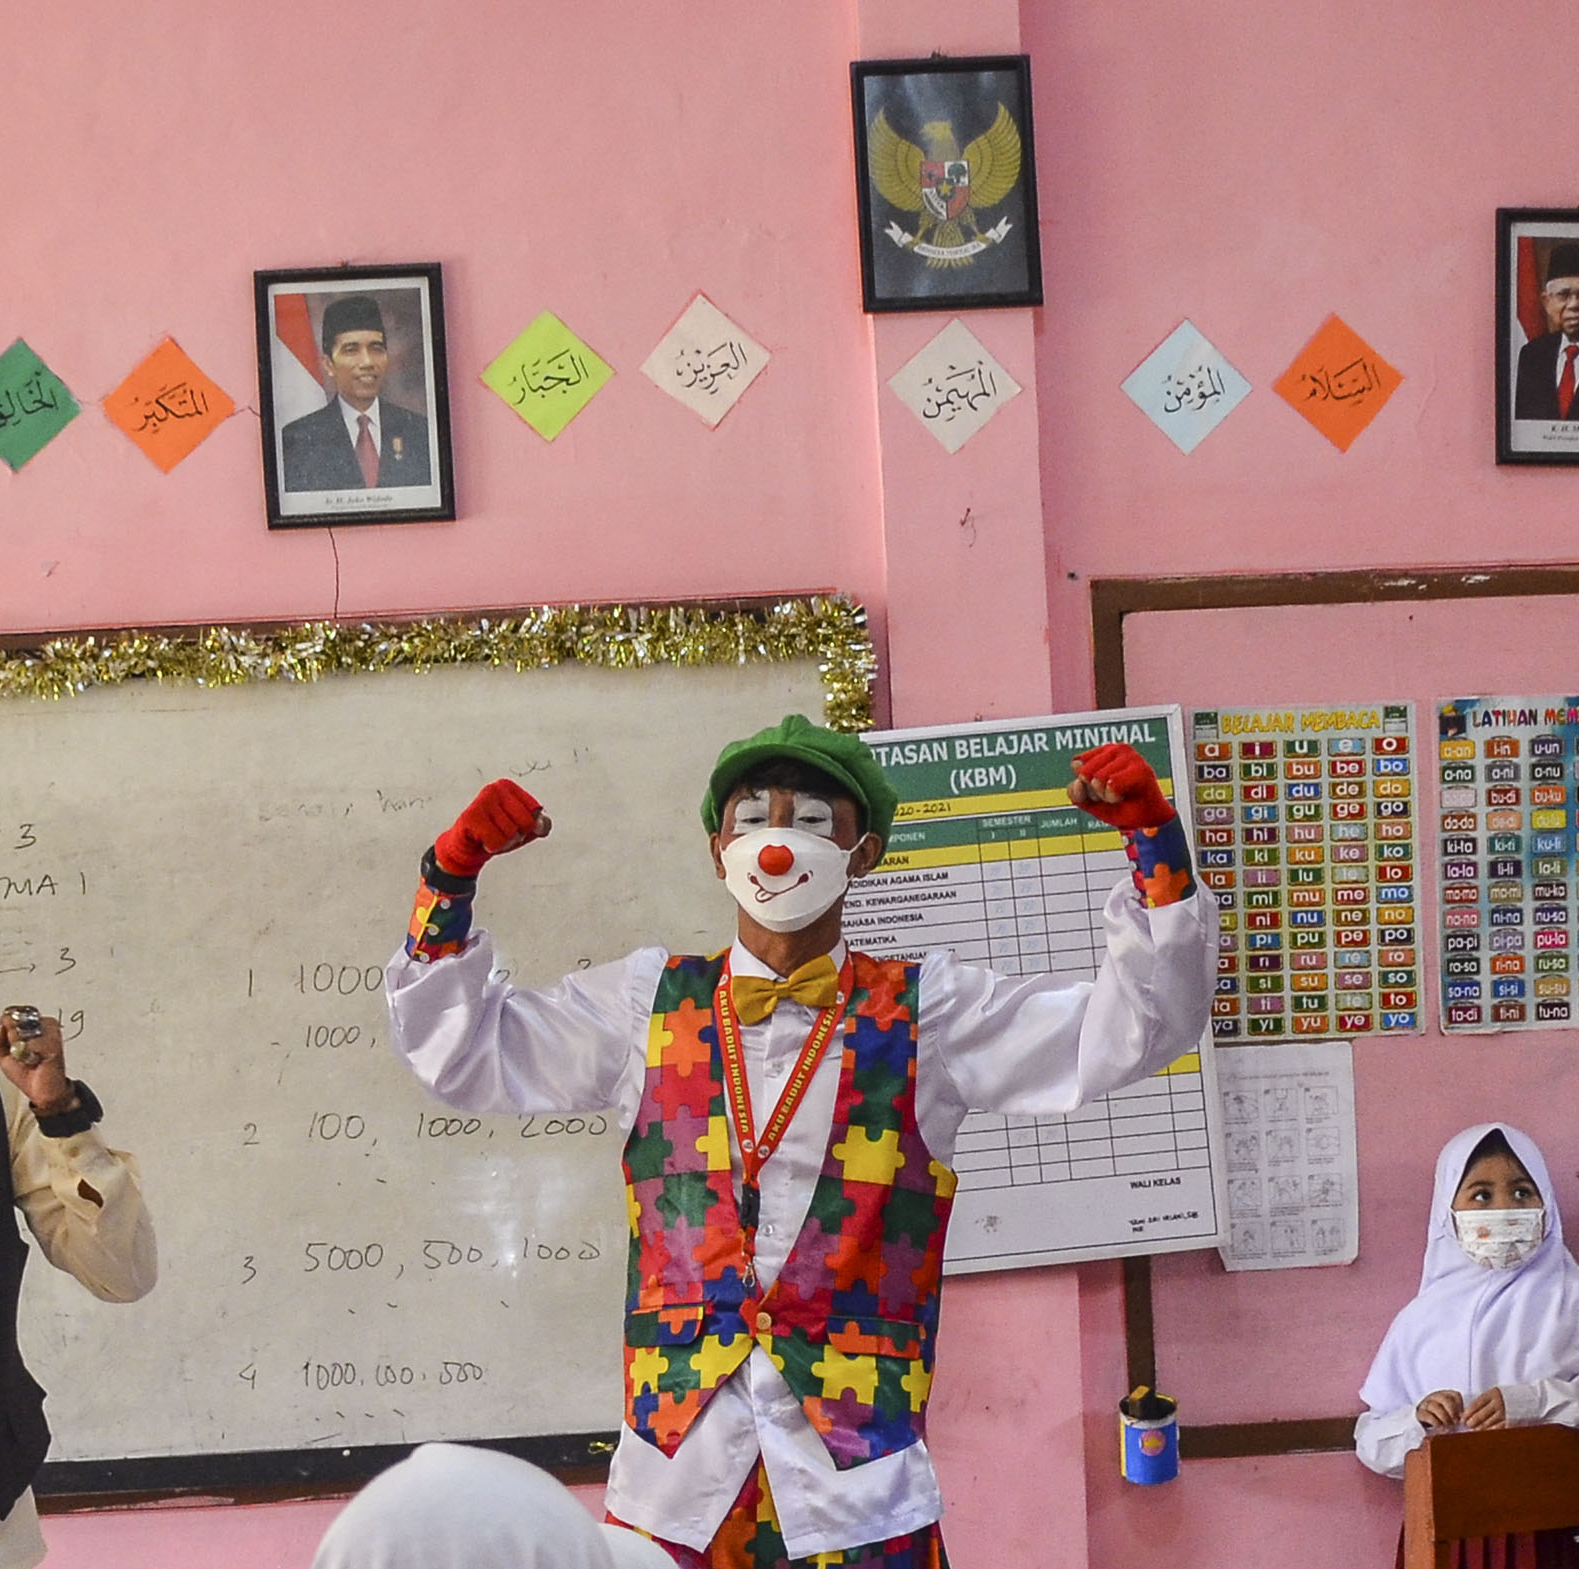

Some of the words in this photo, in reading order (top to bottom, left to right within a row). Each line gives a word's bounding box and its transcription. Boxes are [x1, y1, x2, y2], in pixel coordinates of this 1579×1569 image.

[1222, 711, 1295, 735] BELAJAR
[1300, 710, 1380, 733] MEMBACA
[1472, 705, 1538, 728] LATIHAN
[870, 741, 948, 767] TASAN
[955, 732, 1047, 760] BELAJAR
[1054, 722, 1156, 751] MINIMAL
[1204, 743, 1220, 757] a
[1254, 742, 1260, 756] i
[1294, 740, 1308, 753] u
[1382, 737, 1397, 751] o
[1493, 743, 1511, 756] i-in
[1534, 742, 1560, 754] u-un
[1203, 765, 1226, 779] ba
[1251, 764, 1267, 777] bi
[1292, 762, 1314, 775] bu
[1336, 761, 1359, 774] be
[1380, 759, 1403, 772] bo
[949, 764, 1017, 795] (KBM)
[1203, 787, 1226, 800] da
[1250, 786, 1267, 799] di
[1292, 784, 1314, 797] du
[1336, 783, 1359, 796] de
[1379, 781, 1402, 794] do
[1491, 790, 1517, 803] bu-di
[1534, 789, 1562, 802] bu-ku
[981, 815, 1031, 828] SEMESTER
[1040, 817, 1078, 828] JUMLAH
[1204, 808, 1227, 822] ga
[1251, 807, 1267, 820] gi
[1293, 805, 1315, 817] gu
[1336, 804, 1360, 816] ge
[1380, 802, 1403, 815] go
[13, 823, 38, 850] 3
[1205, 830, 1228, 843] ha
[1253, 829, 1268, 841] hi
[1294, 827, 1315, 840] hu
[1338, 825, 1359, 838] he
[1382, 824, 1404, 837] ho
[1447, 838, 1474, 852] ki-ta
[1206, 852, 1228, 864] ka
[1254, 851, 1268, 863] ki
[1295, 850, 1315, 862] ku
[1339, 848, 1360, 860] ke
[1383, 846, 1404, 858] ko
[890, 874, 921, 886] AGAMA
[923, 872, 948, 882] ISLAM
[1447, 865, 1474, 878] la-la
[1497, 862, 1514, 875] li-li
[1539, 861, 1561, 874] la-li
[865, 891, 957, 907] KEWARGANEGARAAN
[1534, 884, 1566, 898] mu-ka
[877, 913, 923, 925] INDONESIA
[1493, 911, 1521, 924] ni-na
[1535, 910, 1566, 922] nu-sa
[1447, 935, 1478, 949] pa-pi
[1536, 931, 1566, 946] pu-la
[1496, 958, 1520, 970] ri-na
[1538, 957, 1566, 970] ru-sa
[1448, 984, 1480, 997] sa-na
[1499, 983, 1519, 995] si-si
[1539, 982, 1567, 994] su-su
[719, 990, 730, 1017] AKU
[1451, 1008, 1478, 1021] ta-di
[1499, 1006, 1520, 1019] ti-ni
[1538, 1005, 1568, 1018] tu-na
[722, 1019, 738, 1061] BADUT
[730, 1063, 749, 1133] INDONESIA
[768, 1114, 785, 1141] AKU
[782, 1073, 806, 1115] BADUT
[242, 1123, 260, 1147] 2
[520, 1114, 608, 1137] 2000
[1130, 1181, 1151, 1189] WALI
[1153, 1177, 1181, 1188] KELAS
[241, 1255, 257, 1285] 3
[238, 1362, 257, 1391] 4
